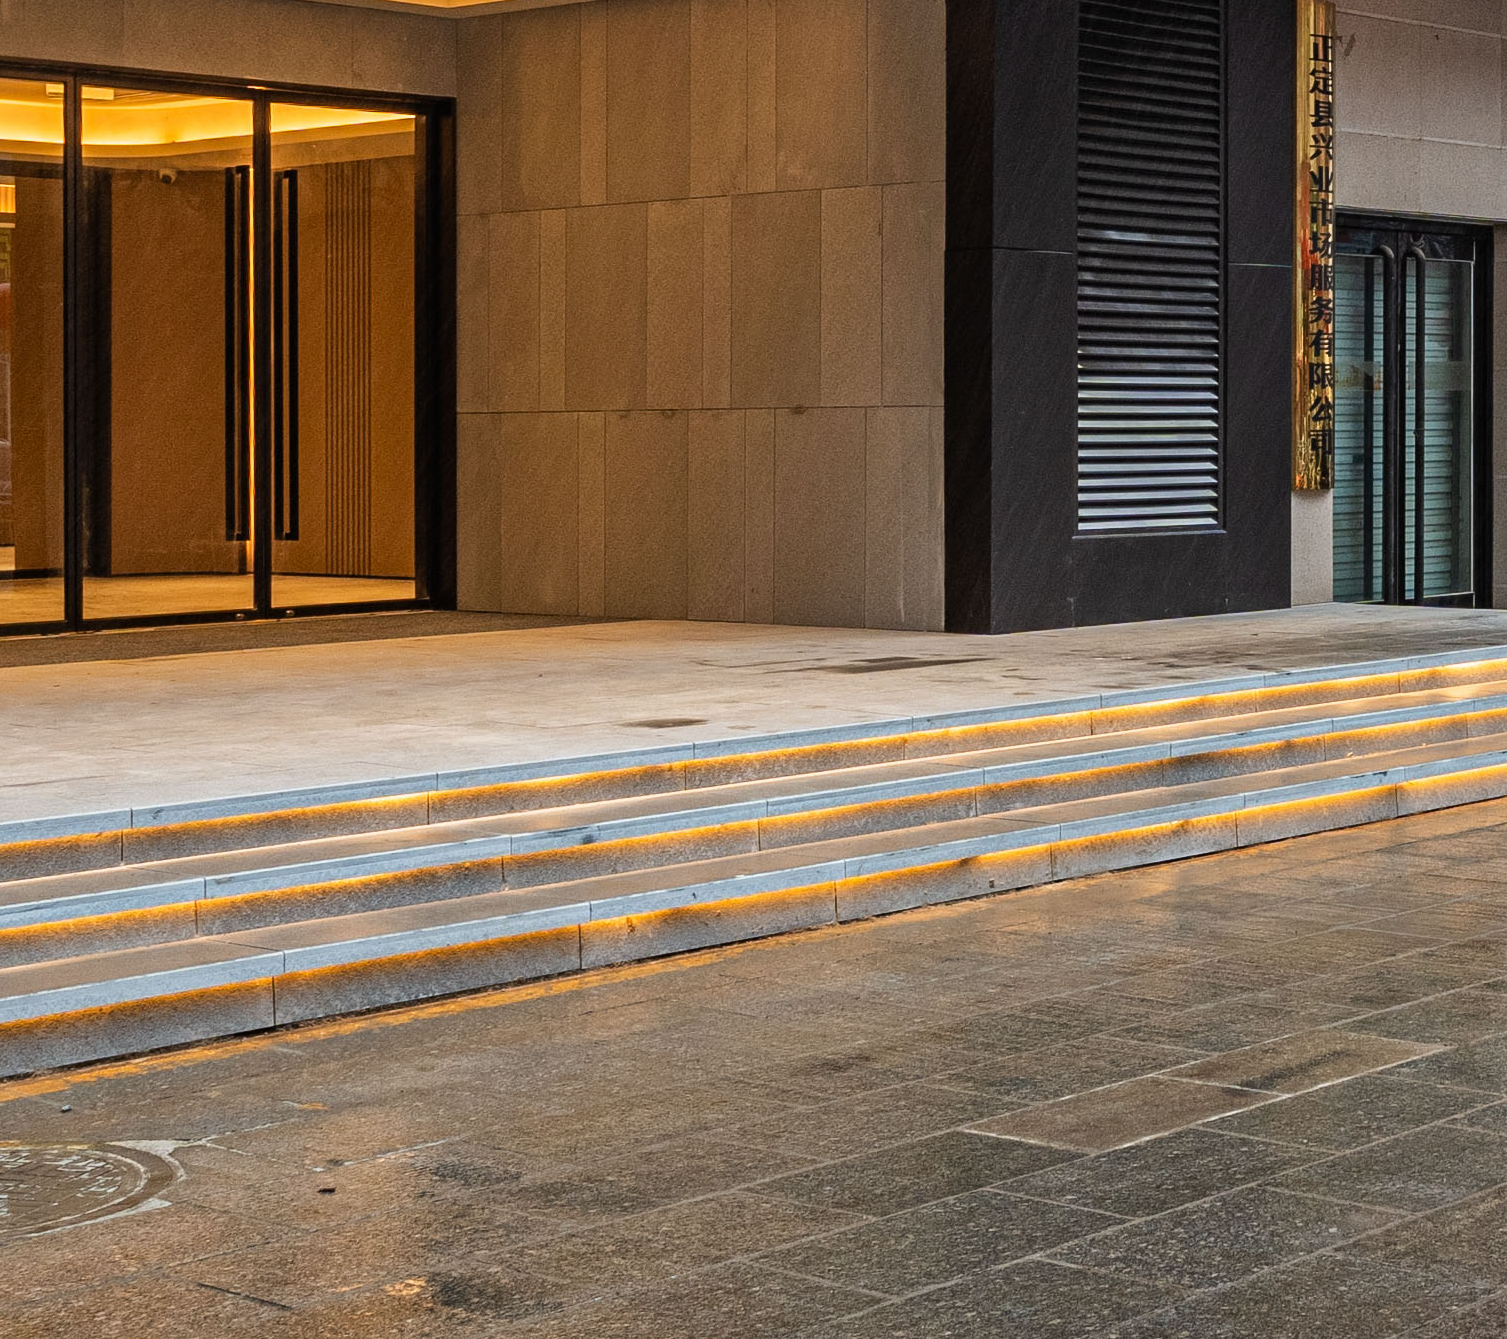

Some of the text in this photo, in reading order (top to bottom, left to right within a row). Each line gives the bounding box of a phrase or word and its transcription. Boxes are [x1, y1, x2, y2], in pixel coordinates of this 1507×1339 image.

[1308, 32, 1335, 458] 正定县兴业市场服务有限公司
